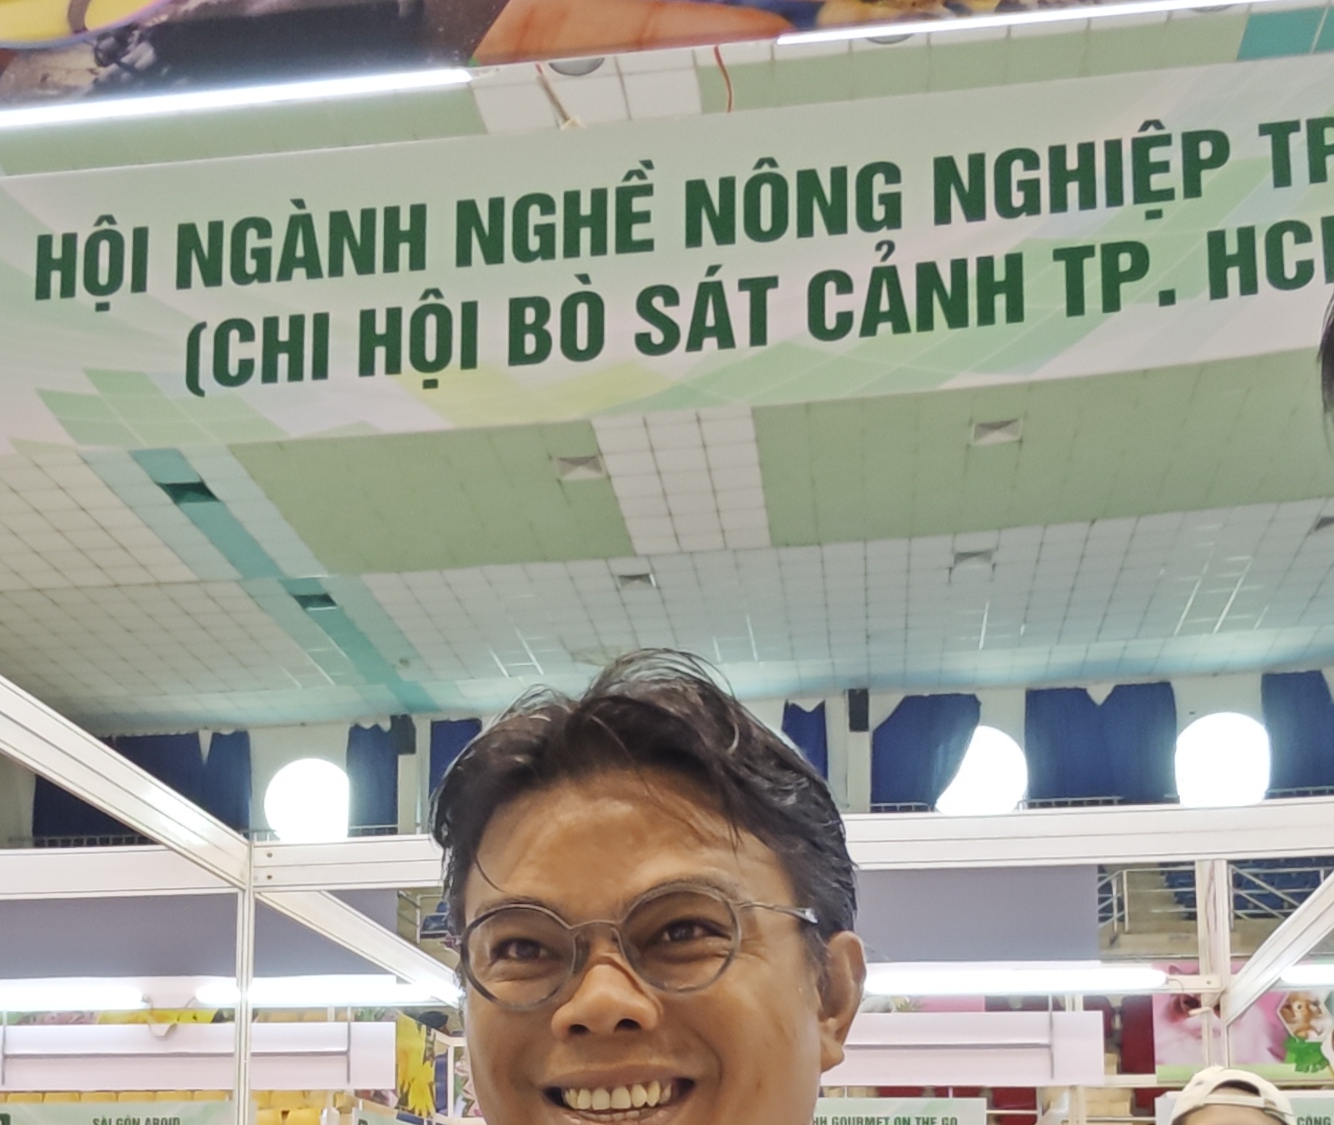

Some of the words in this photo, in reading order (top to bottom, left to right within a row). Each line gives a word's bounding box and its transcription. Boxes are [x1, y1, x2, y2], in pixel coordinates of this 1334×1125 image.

[35, 214, 149, 312] HỘI
[175, 198, 427, 290] NGÀNH
[455, 160, 656, 267] NGHỀ
[685, 157, 902, 248] NÔNG
[933, 119, 1231, 226] NGHIỆP
[185, 311, 330, 398] (CHI
[358, 287, 479, 389] HỘI
[508, 273, 605, 366] BÒ
[634, 264, 779, 356] SÁT
[807, 239, 1025, 341] CẢNH
[1053, 240, 1176, 318] TP.
